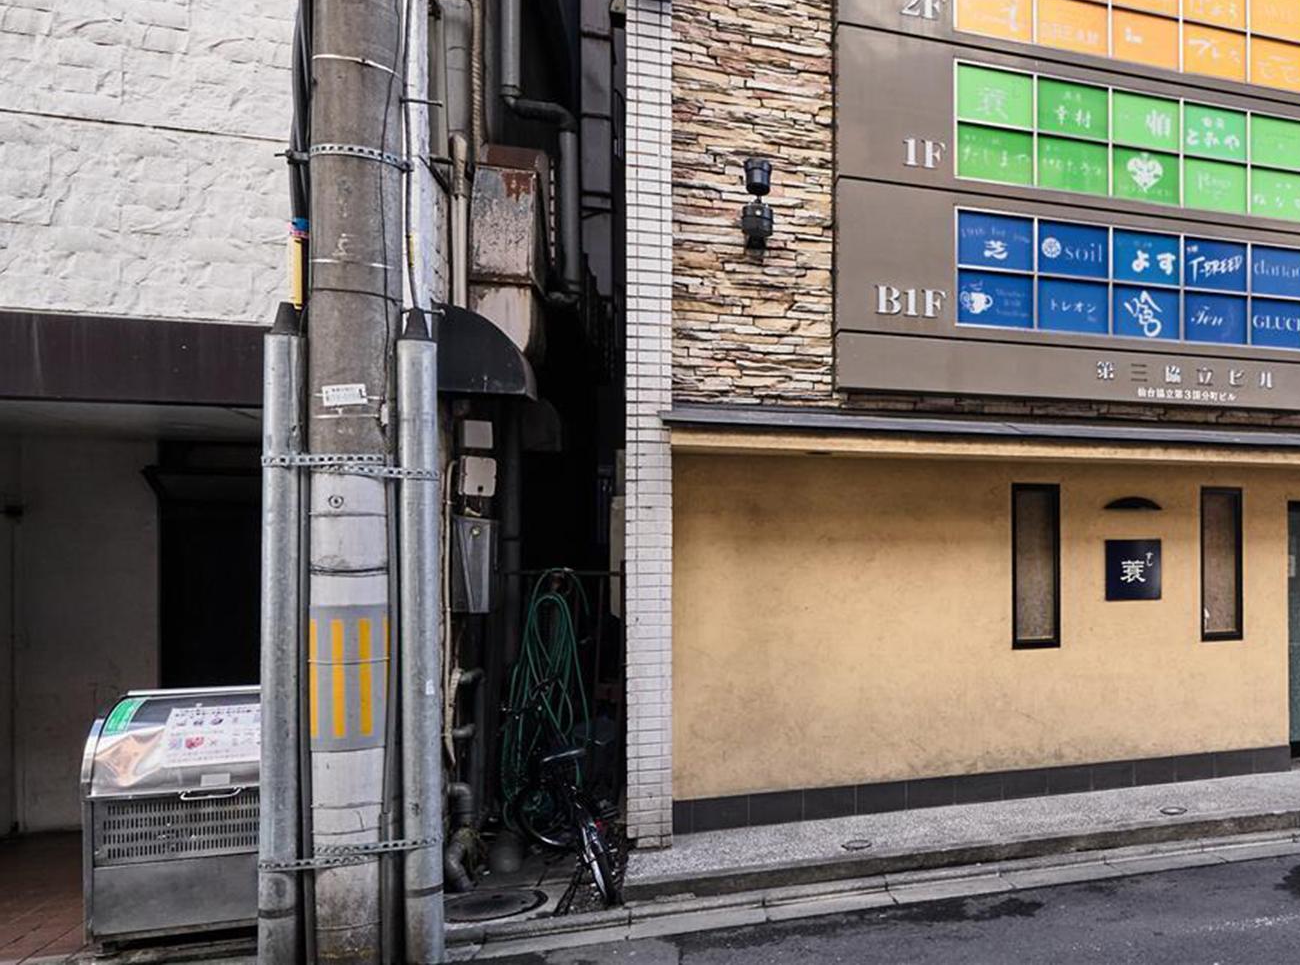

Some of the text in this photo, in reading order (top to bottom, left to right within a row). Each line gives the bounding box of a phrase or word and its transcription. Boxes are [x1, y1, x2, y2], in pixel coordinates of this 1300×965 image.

[902, 137, 946, 170] 1F
[1064, 243, 1103, 263] soil
[875, 284, 947, 320] B1F
[1096, 361, 1273, 389] 第三協立ビル
